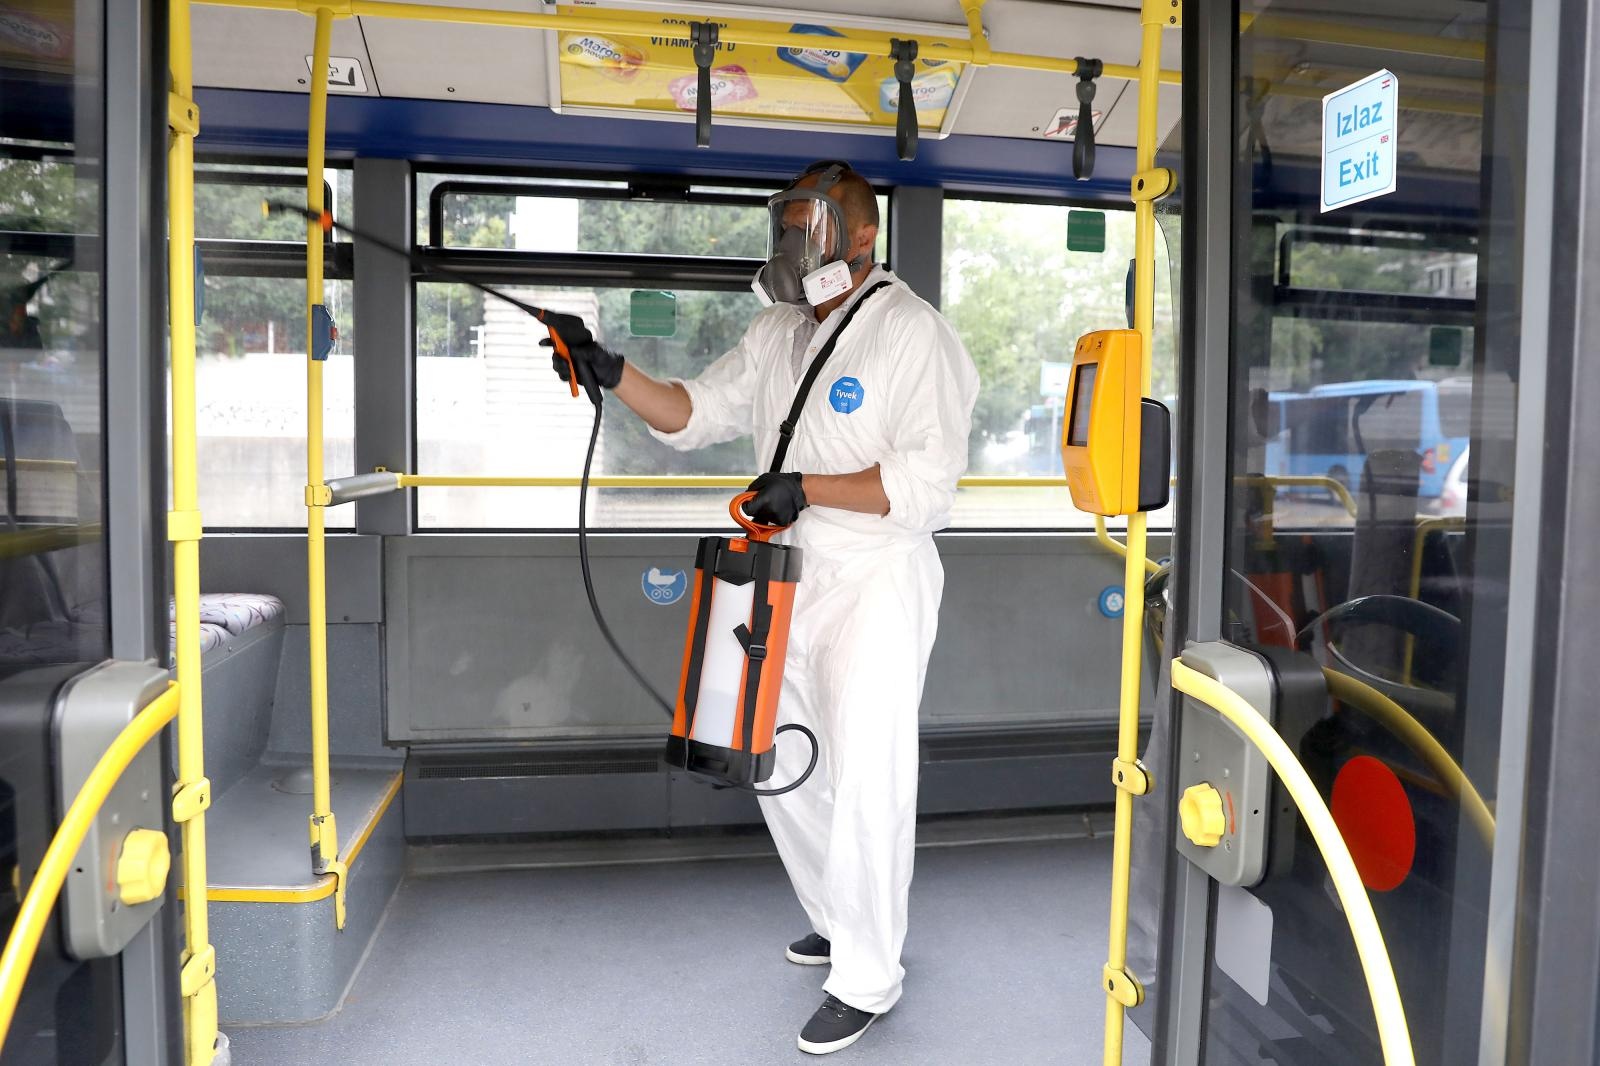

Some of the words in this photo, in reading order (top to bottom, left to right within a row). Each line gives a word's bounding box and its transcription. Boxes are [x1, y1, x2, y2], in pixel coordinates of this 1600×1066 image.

[580, 38, 621, 60] Margo
[687, 81, 726, 96] Mgo
[1336, 100, 1383, 138] Izlaz
[1339, 149, 1379, 188] Exit
[836, 389, 857, 400] Tyvek
